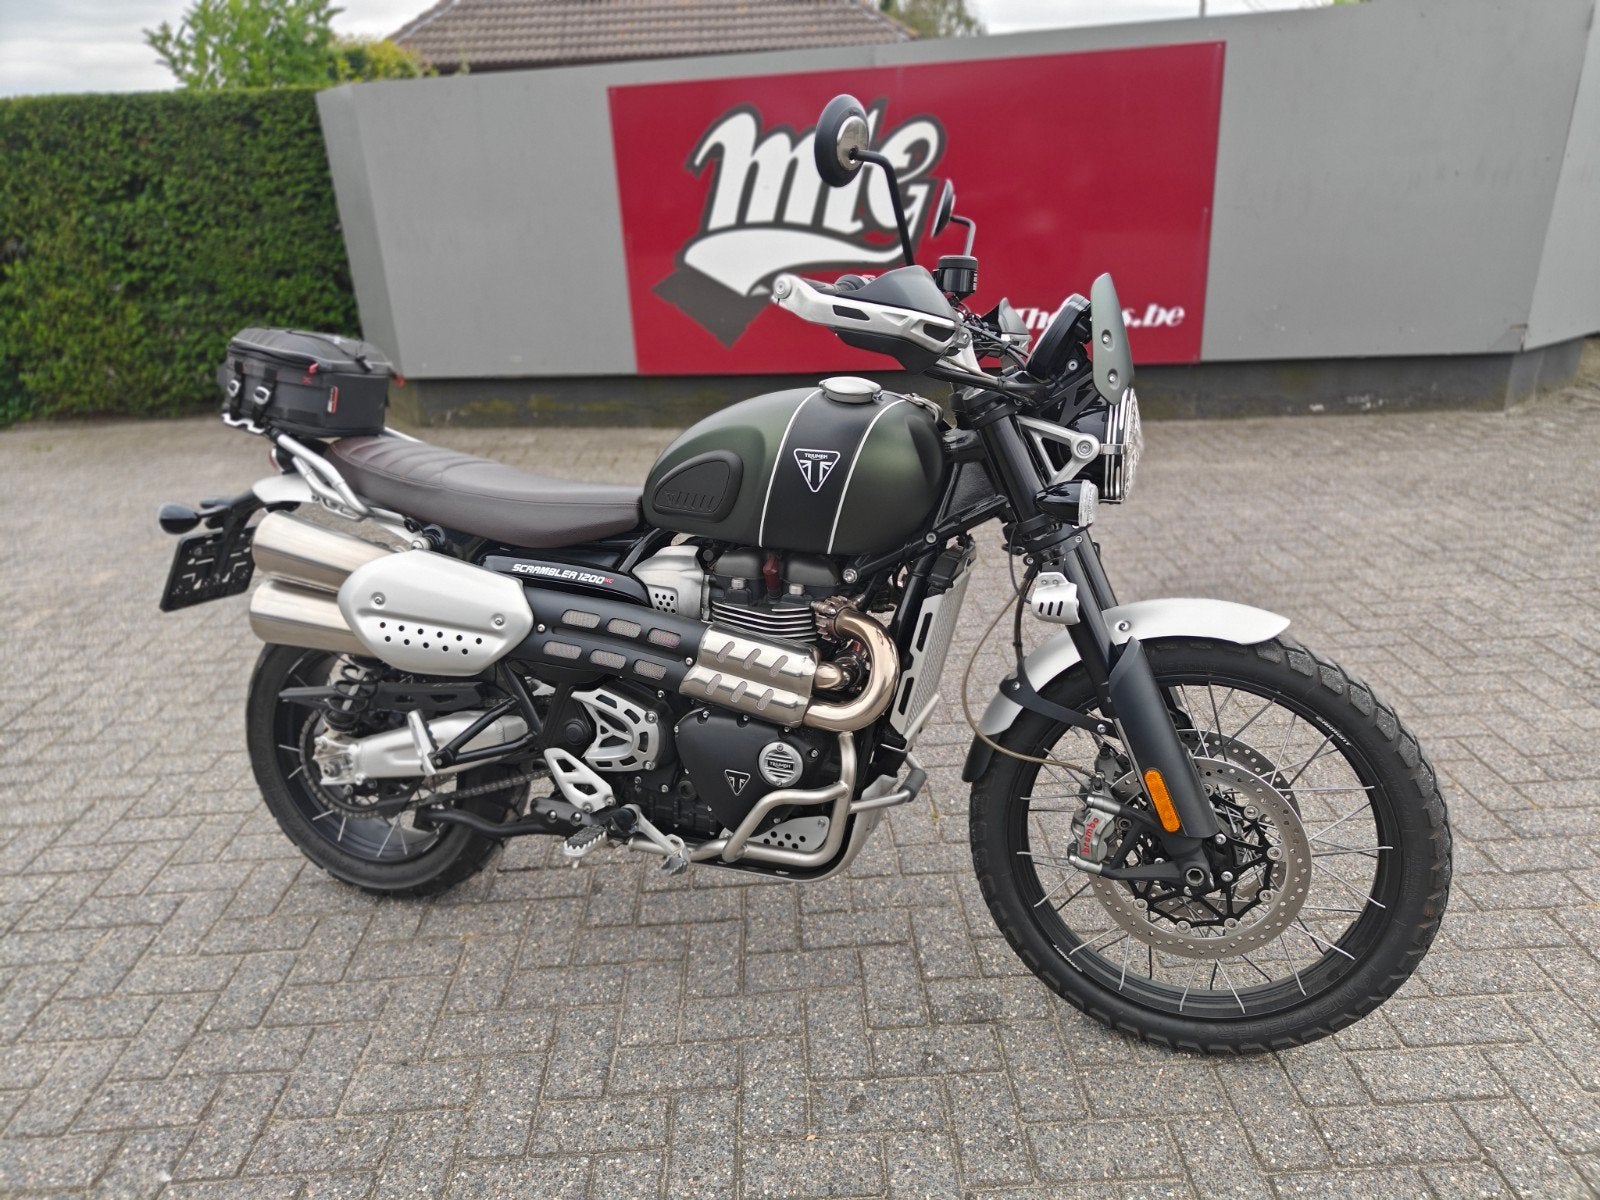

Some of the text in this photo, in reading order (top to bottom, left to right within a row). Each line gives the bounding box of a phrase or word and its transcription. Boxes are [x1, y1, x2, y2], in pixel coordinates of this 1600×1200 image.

[512, 563, 577, 579] SCRAMBLER
[578, 572, 605, 584] 1200
[769, 761, 791, 769] TRIUMPH
[1081, 817, 1099, 855] brembo
